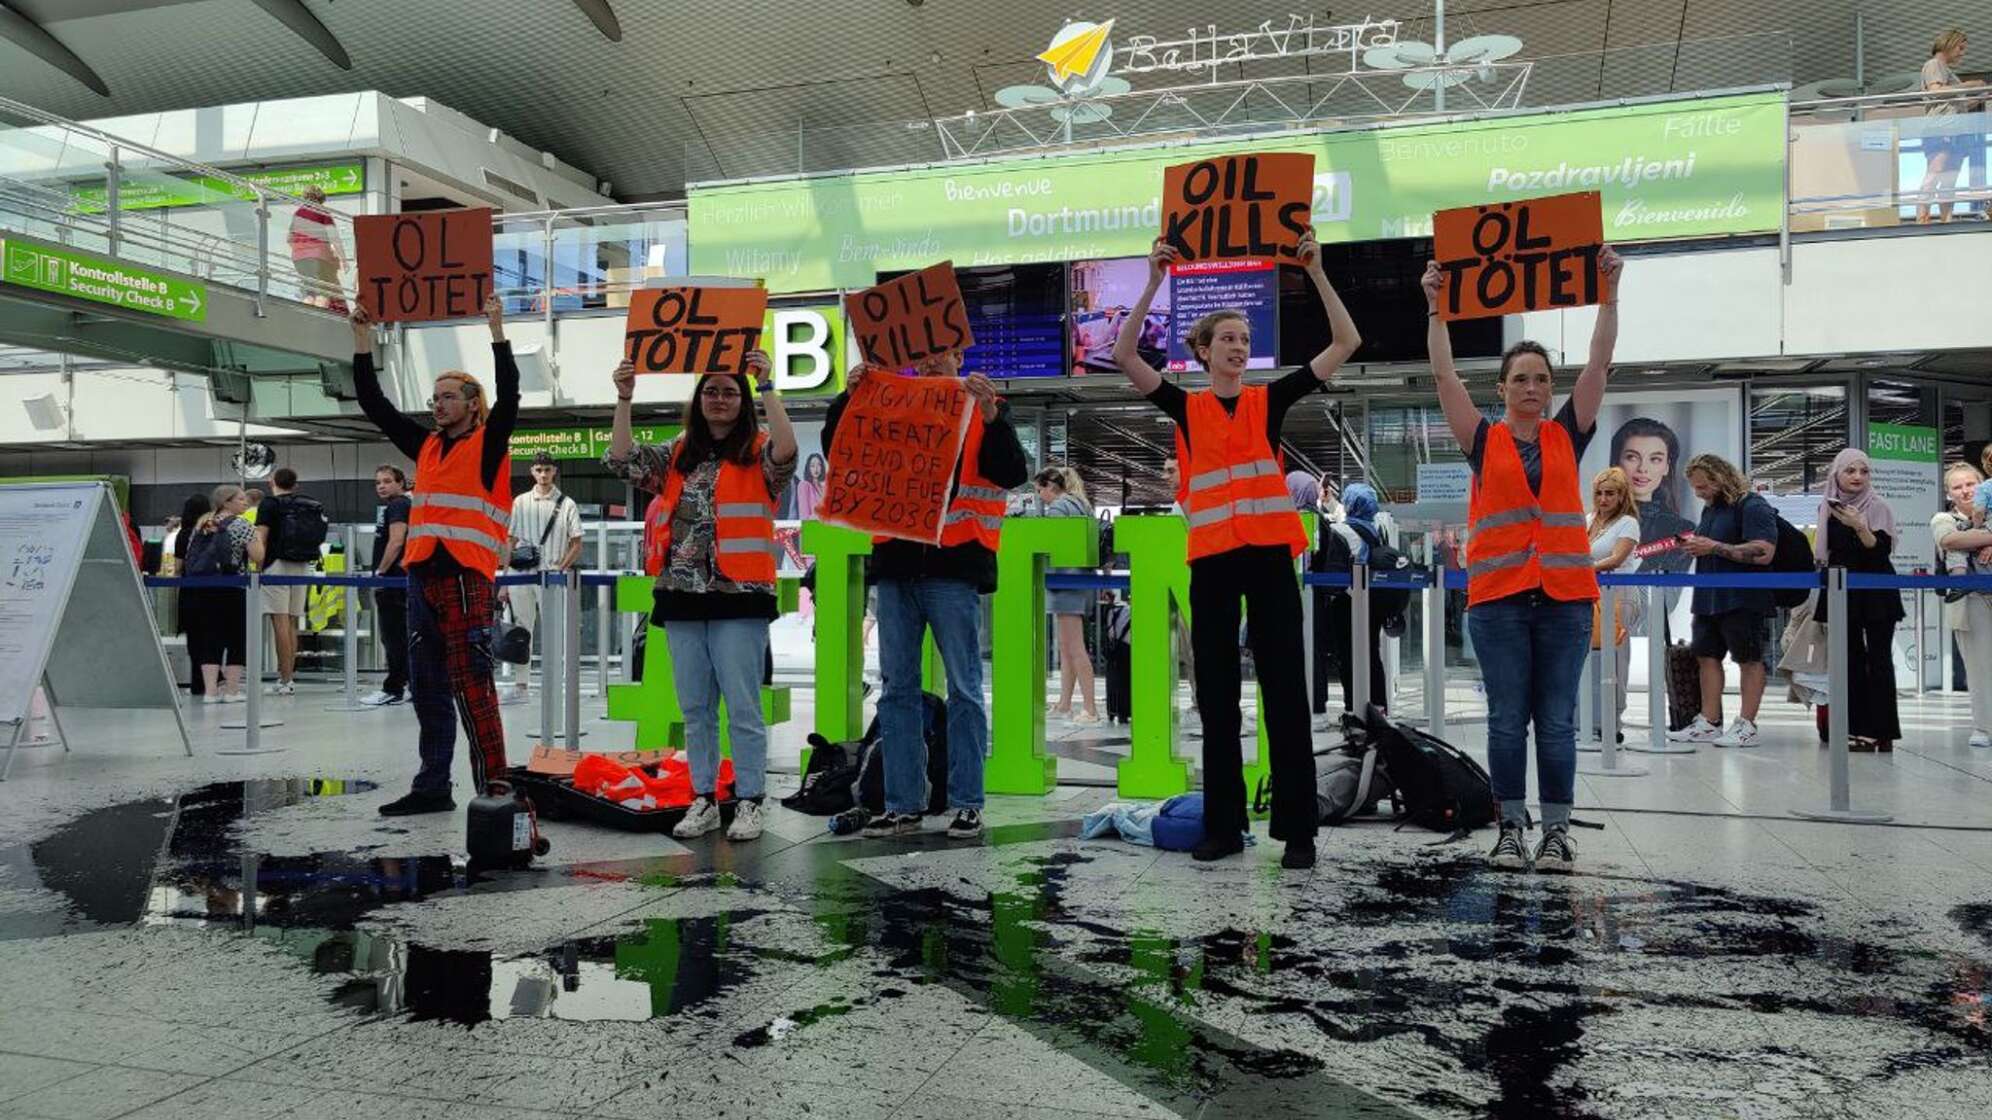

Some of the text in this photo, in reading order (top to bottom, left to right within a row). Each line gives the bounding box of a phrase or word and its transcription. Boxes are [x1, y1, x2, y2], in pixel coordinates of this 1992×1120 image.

[1664, 113, 1742, 140] Fáilte
[1381, 134, 1528, 162] Benvenuto
[945, 178, 1053, 201] Bienvenue
[1183, 157, 1275, 205] OIL
[1488, 151, 1697, 192] Pozdravljeni
[1008, 197, 1160, 237] Dortmund
[1614, 191, 1750, 229] Bienvenido
[393, 215, 464, 271] ÖL
[1168, 202, 1311, 260] KILLS
[1472, 203, 1551, 255] ÖL
[70, 261, 157, 292] Kontrollstelle
[726, 248, 801, 275] Witamy
[1440, 241, 1603, 314] TÖTET
[70, 278, 124, 303] Security
[126, 290, 163, 308] Check
[370, 273, 489, 317] TÖTET
[652, 287, 718, 327] ÖL
[864, 275, 945, 322] OIL
[626, 328, 762, 373] TÖTET
[773, 310, 831, 390] B
[861, 298, 964, 366] KILLS
[863, 381, 965, 417] IGN THE
[548, 444, 579, 455] Check
[580, 443, 587, 454] B
[574, 432, 582, 443] B
[594, 431, 613, 442] Gat
[641, 430, 653, 441] 12
[854, 415, 951, 449] TREATY
[1868, 431, 1936, 454] FAST LANE
[862, 442, 942, 477] END OF
[830, 487, 867, 514] BY
[831, 467, 896, 497] FOSSIL
